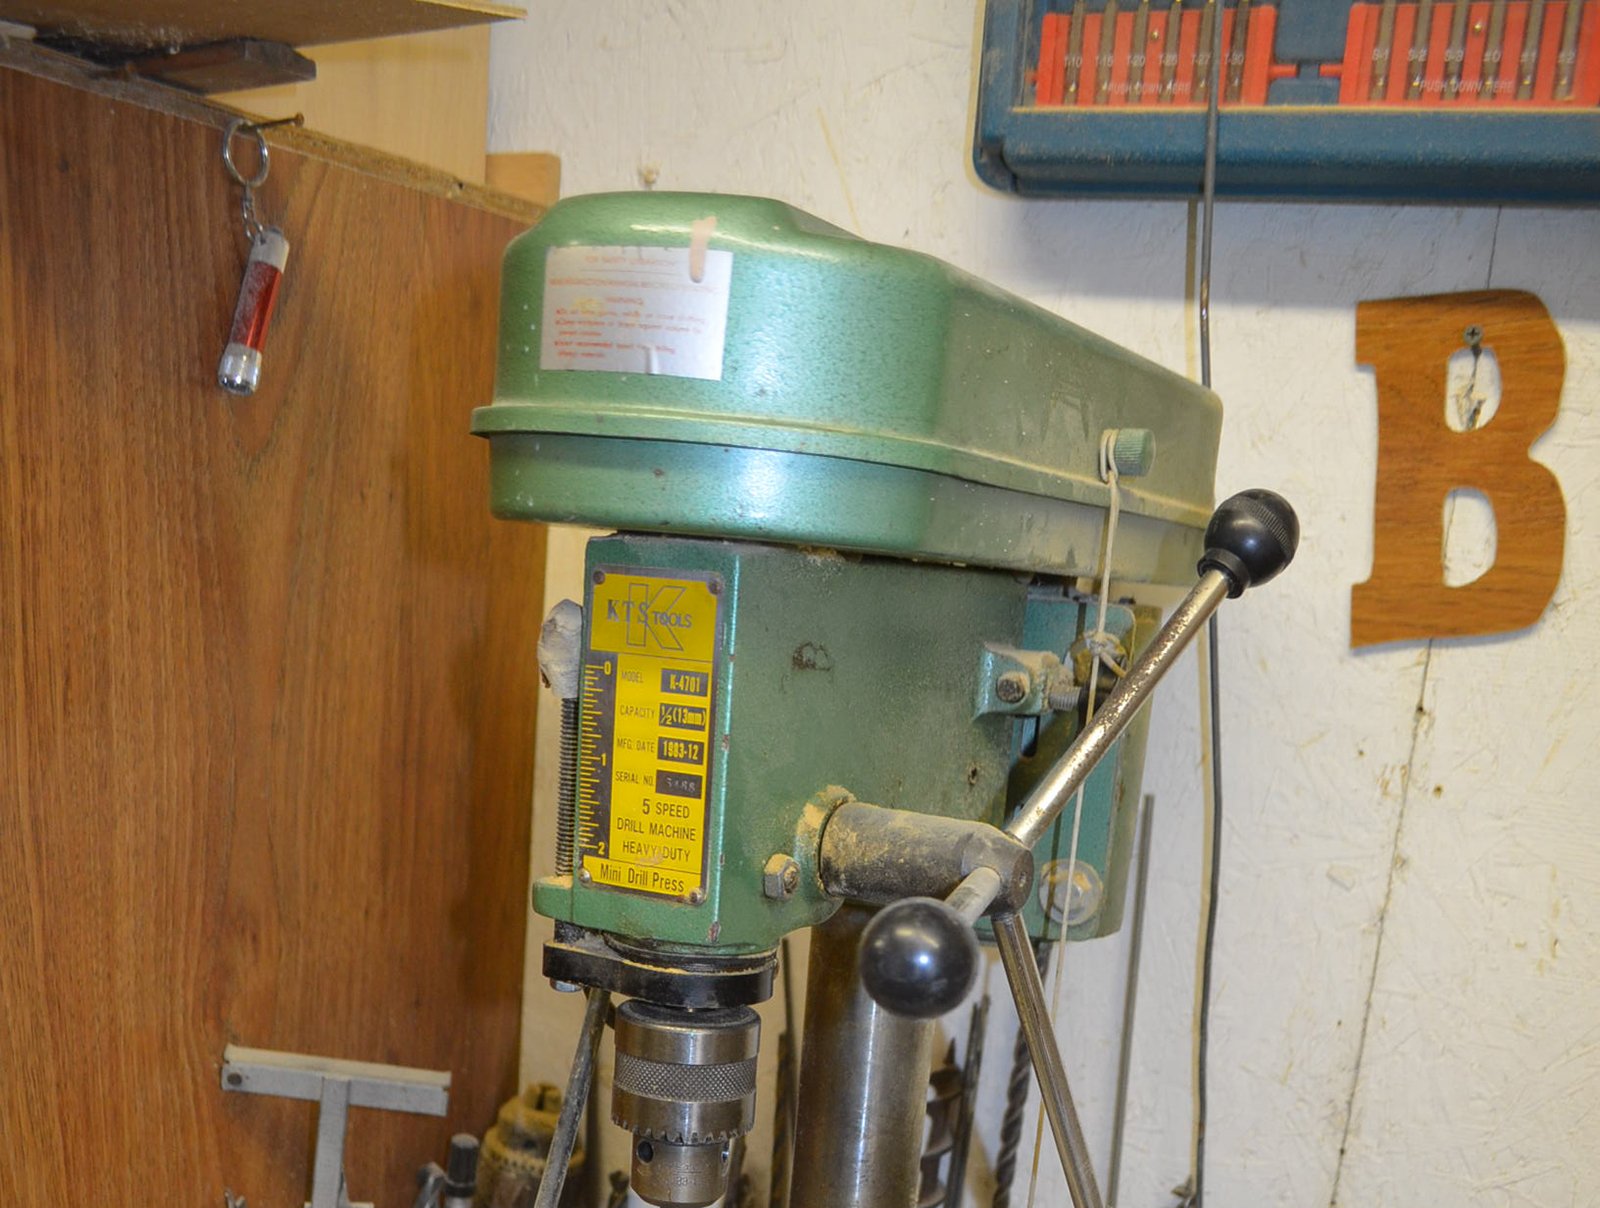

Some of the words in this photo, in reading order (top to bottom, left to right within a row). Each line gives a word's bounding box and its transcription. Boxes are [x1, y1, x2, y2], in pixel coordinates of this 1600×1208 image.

[1419, 80, 1447, 92] PUSH
[1451, 80, 1481, 92] DOWN
[1350, 289, 1567, 648] B
[626, 583, 688, 651] K
[652, 611, 692, 628] TOOLS
[621, 670, 644, 683] MODEL
[669, 673, 700, 692] K-4701
[619, 704, 655, 720] CAPACITY
[636, 740, 655, 753] DATE
[601, 753, 607, 766] 1
[615, 771, 639, 784] SERIAL
[642, 798, 650, 815] 5
[655, 801, 690, 819] SPEED
[617, 817, 644, 834] DRILL
[650, 822, 696, 841] MACHINE
[598, 842, 605, 855] 2
[622, 840, 658, 857] HEAVY
[663, 846, 691, 862] DUTY
[600, 863, 621, 882] Mini
[628, 867, 648, 885] Drill
[652, 872, 684, 892] Press
